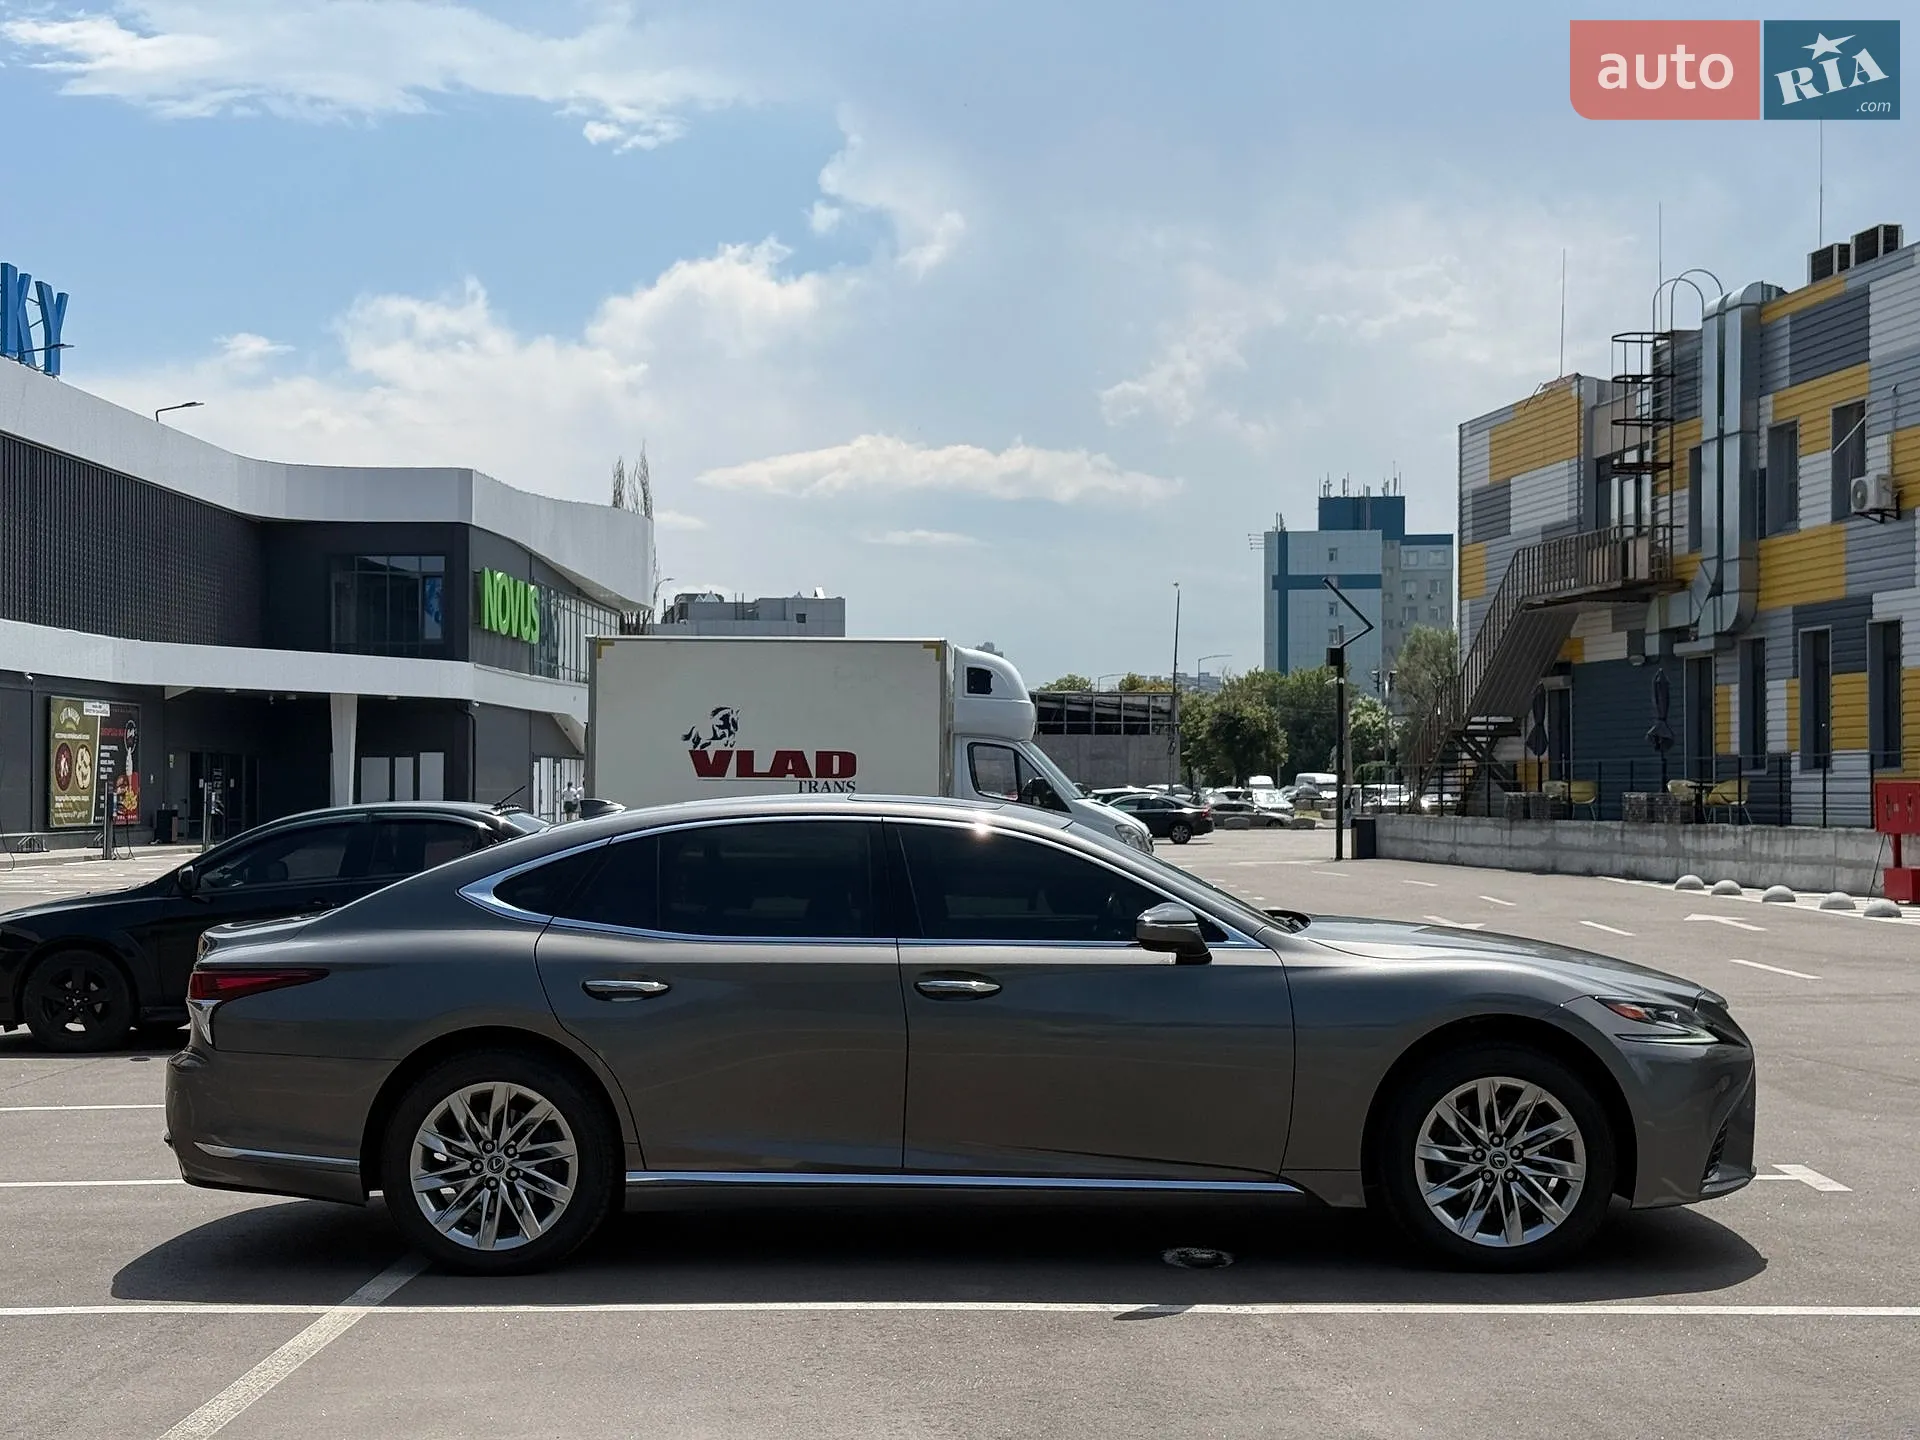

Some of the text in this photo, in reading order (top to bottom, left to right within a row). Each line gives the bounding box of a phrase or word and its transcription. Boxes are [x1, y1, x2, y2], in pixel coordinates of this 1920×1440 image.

[480, 567, 540, 645] NOVUS
[689, 750, 857, 779] VLAD
[798, 780, 856, 793] TRANS
